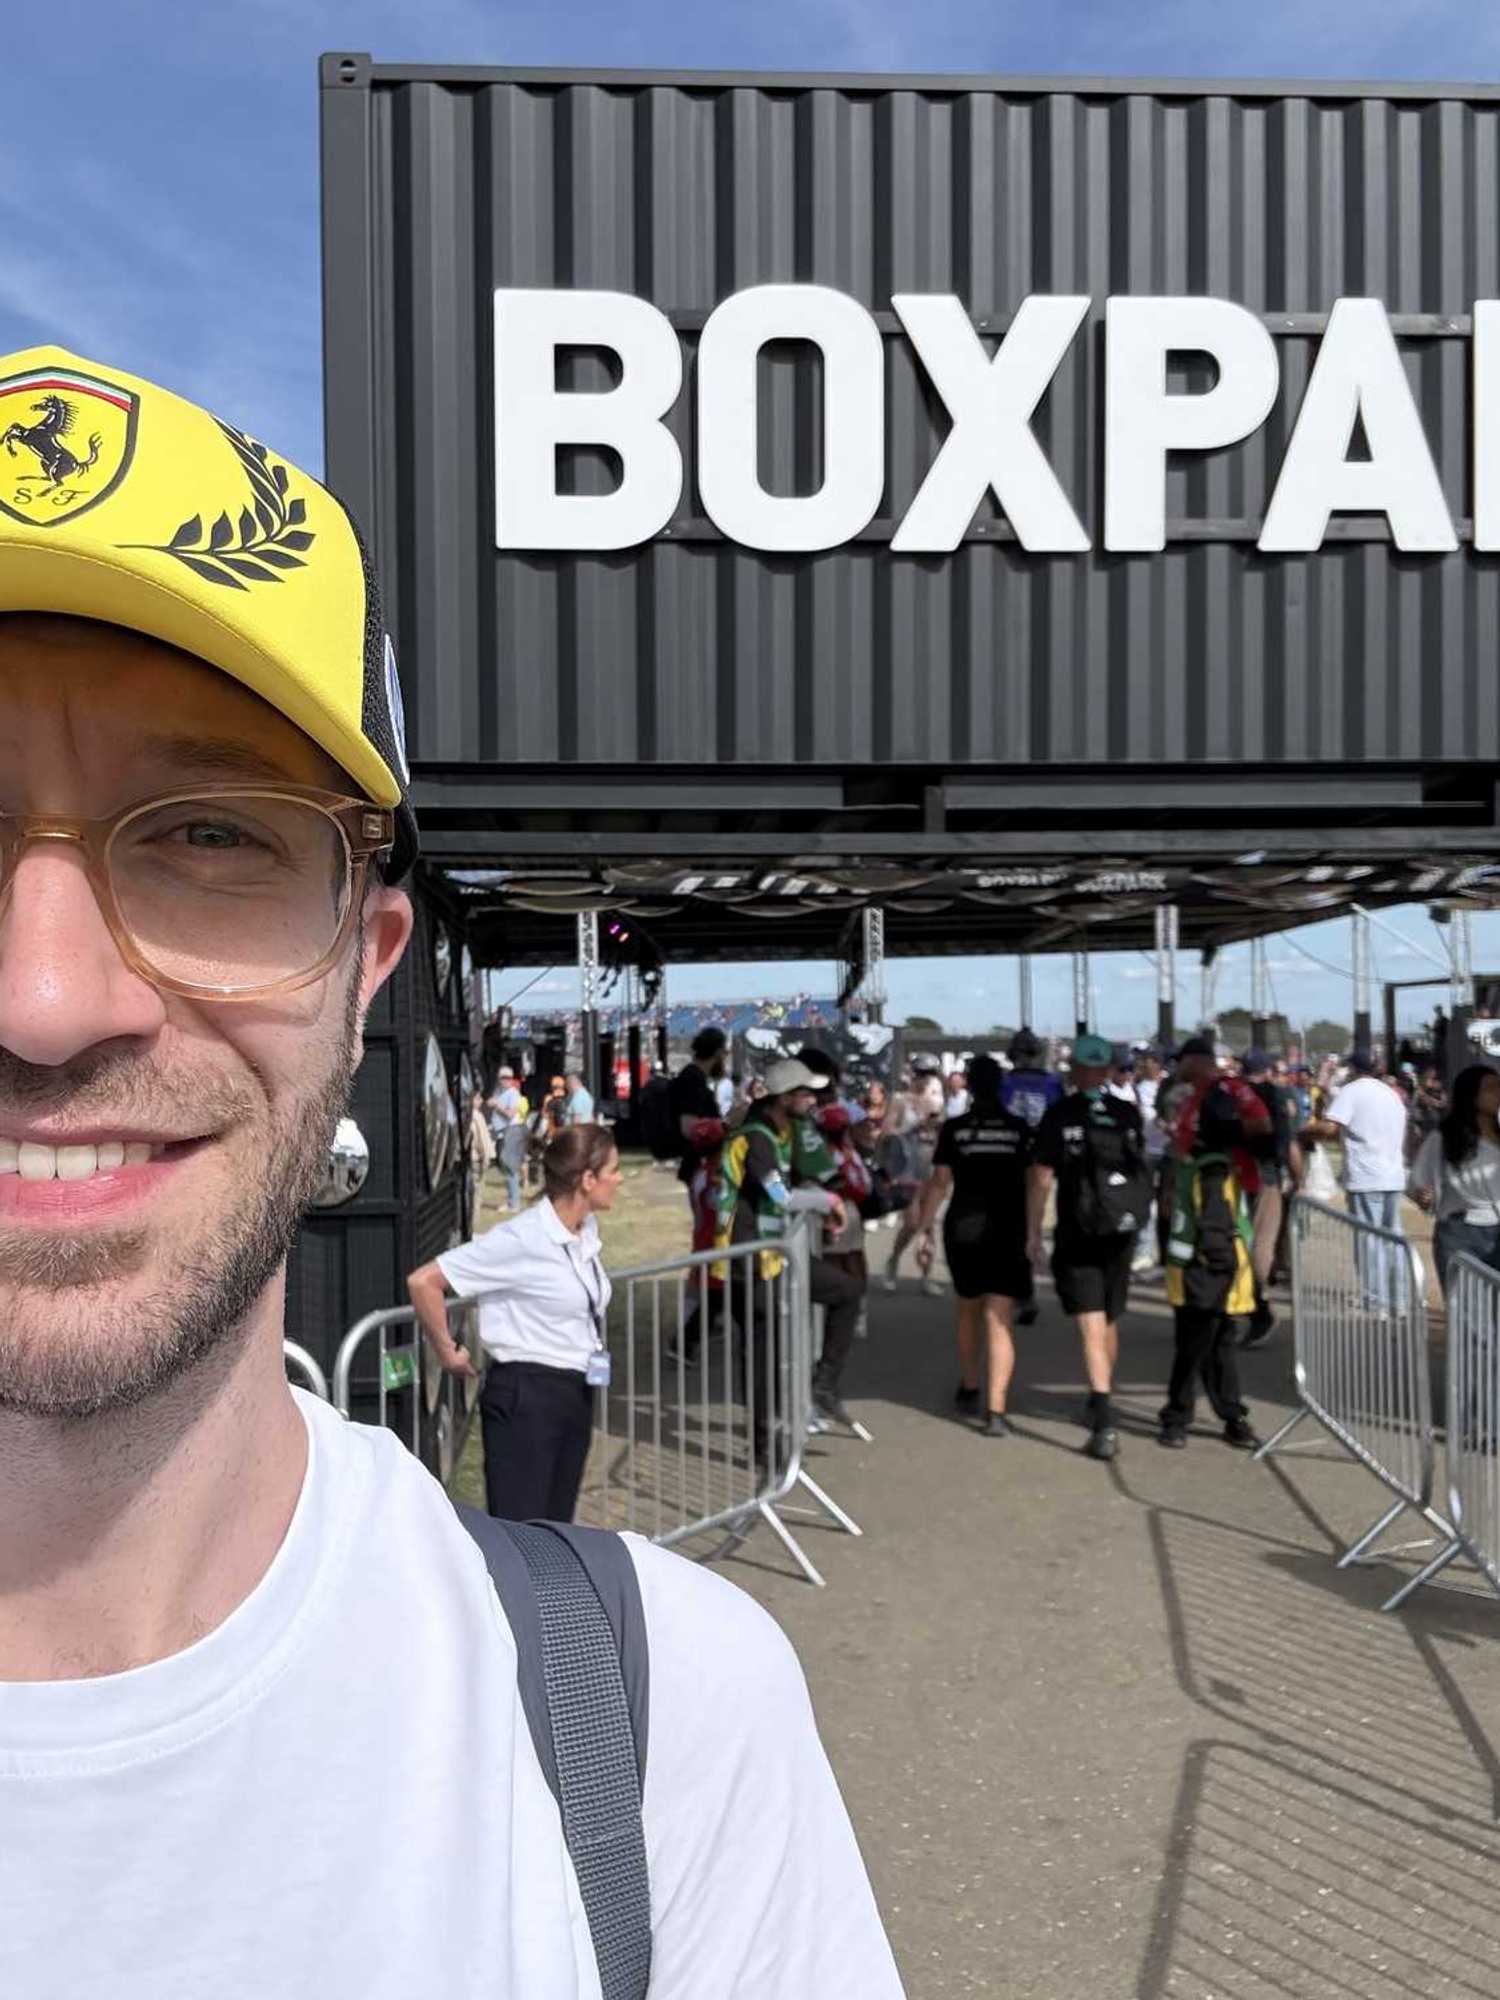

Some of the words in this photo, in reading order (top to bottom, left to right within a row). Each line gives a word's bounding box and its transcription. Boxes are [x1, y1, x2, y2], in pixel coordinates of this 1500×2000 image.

[494, 283, 1500, 553] BOXPA
[13, 487, 33, 505] S
[51, 489, 91, 506] F
